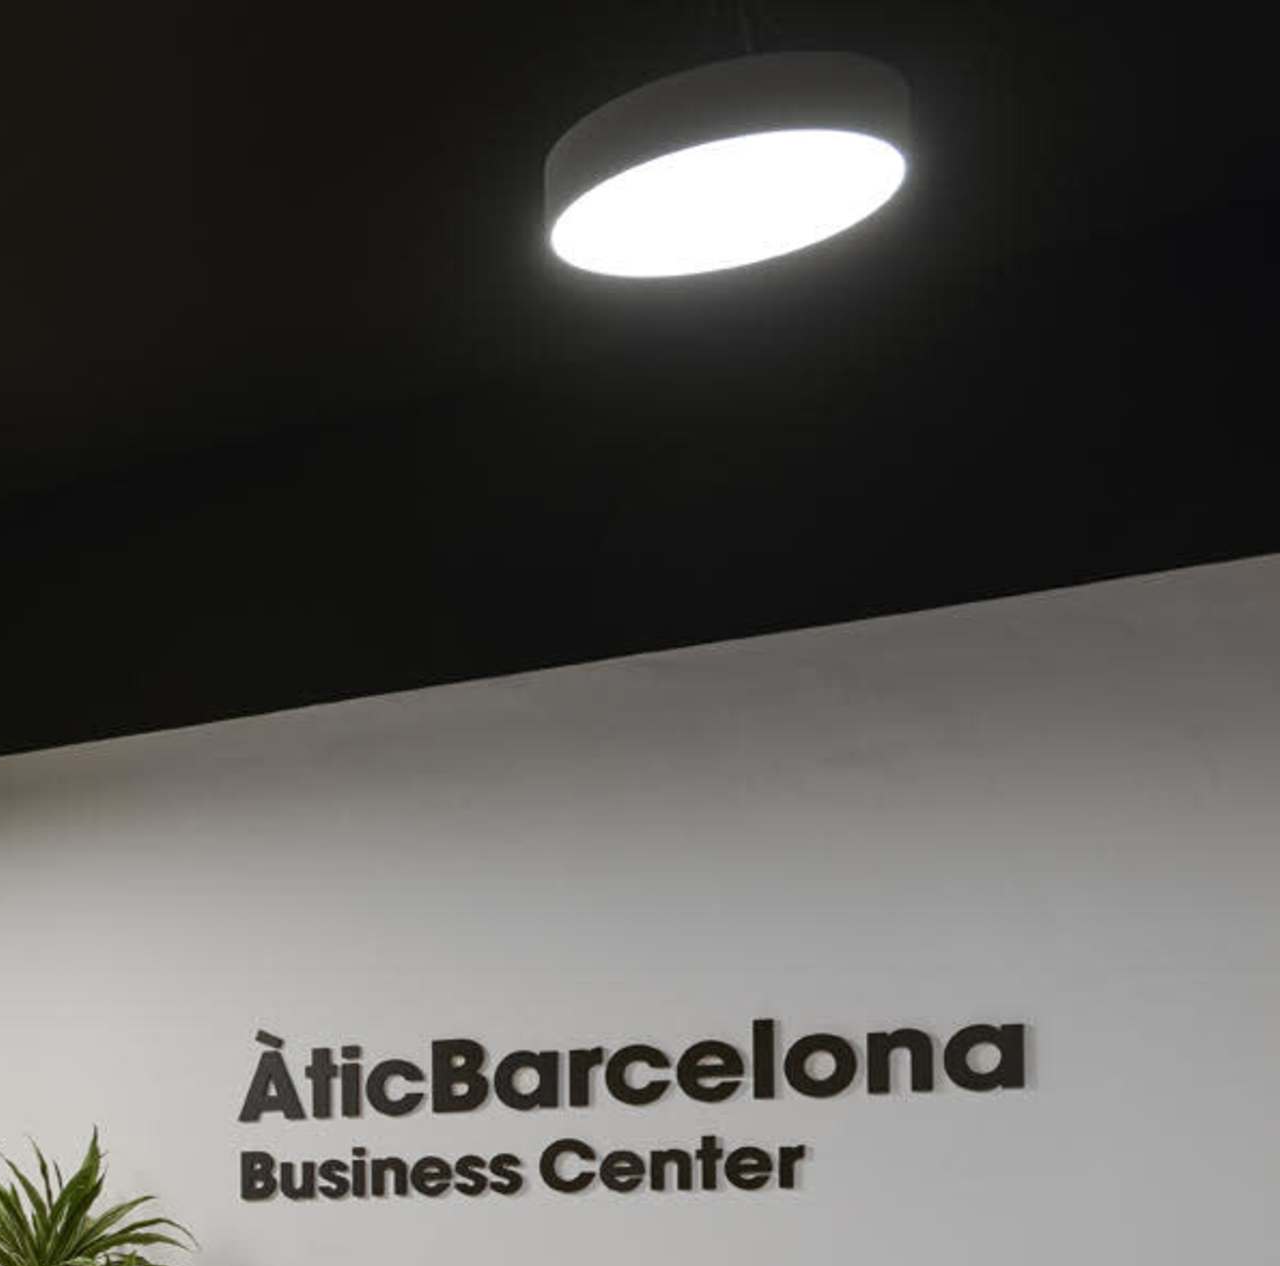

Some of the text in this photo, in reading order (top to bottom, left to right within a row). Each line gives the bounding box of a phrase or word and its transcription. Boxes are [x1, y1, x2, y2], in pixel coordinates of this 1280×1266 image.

[237, 1018, 1026, 1122] ÀticBarcelona
[240, 1136, 806, 1201] Business Center
